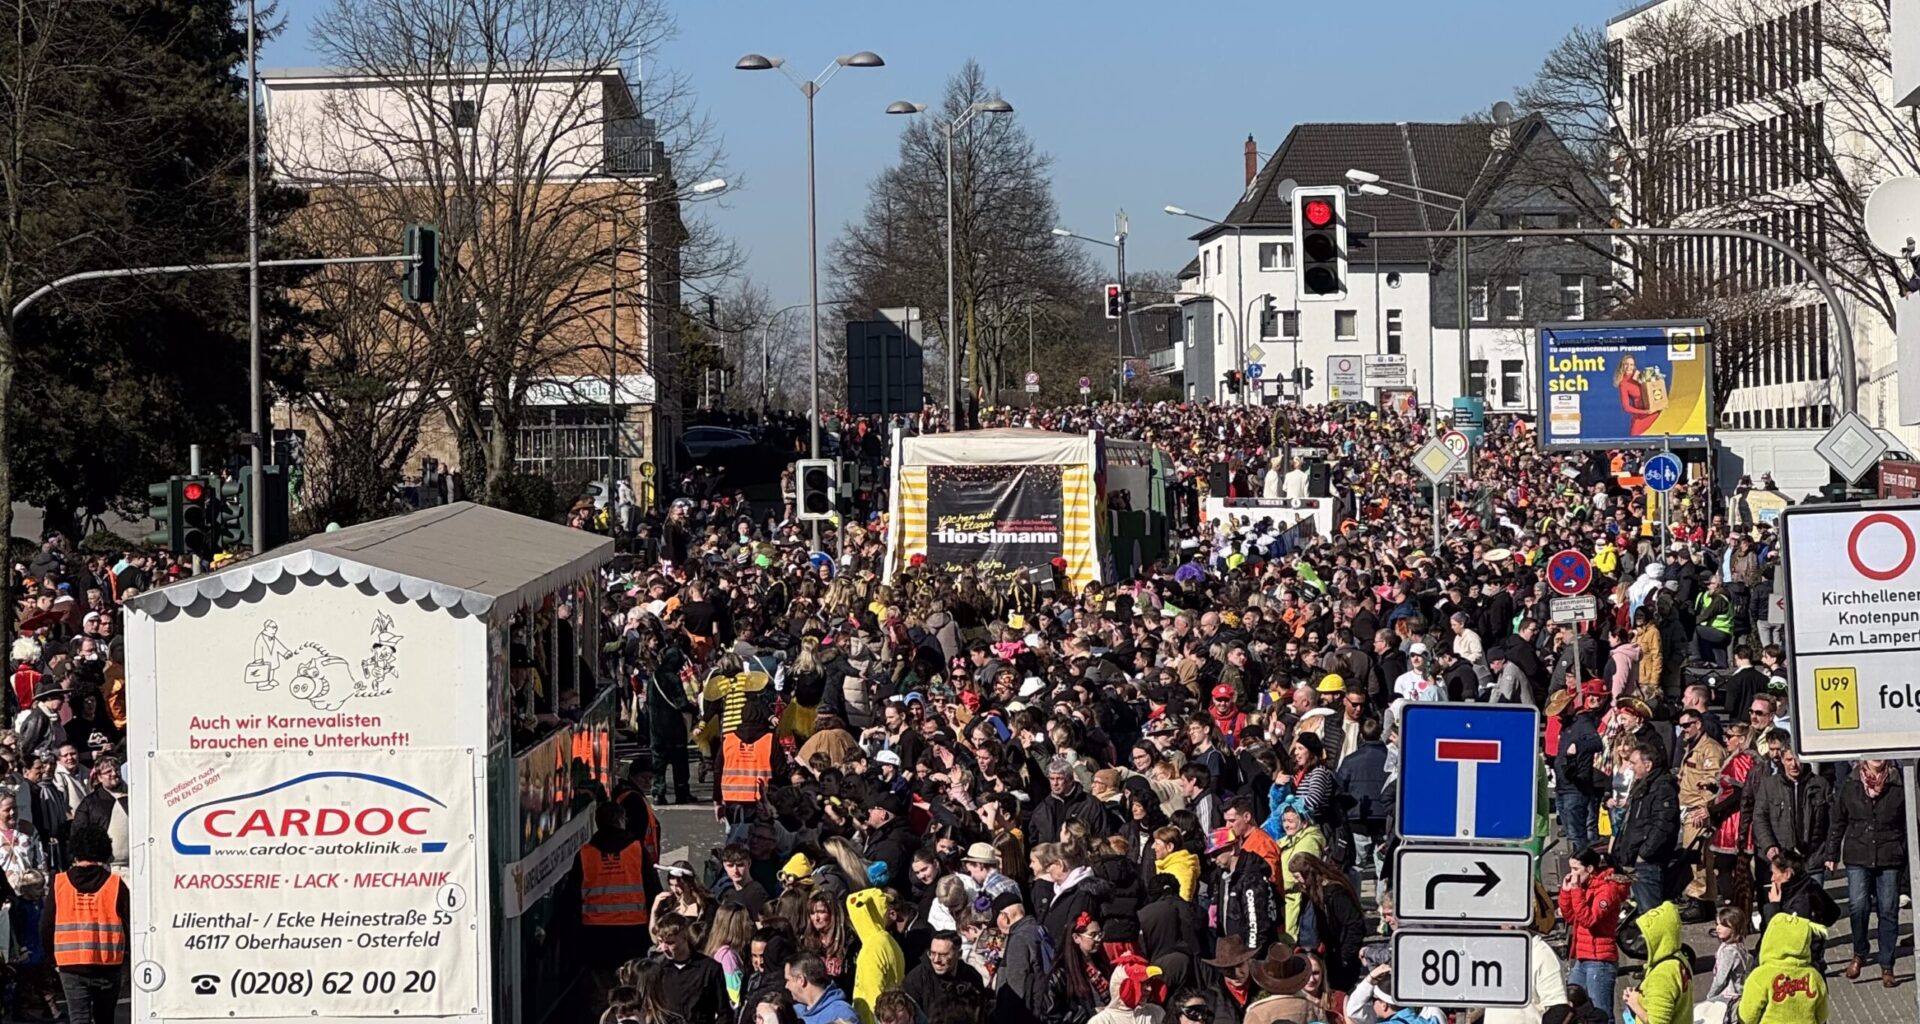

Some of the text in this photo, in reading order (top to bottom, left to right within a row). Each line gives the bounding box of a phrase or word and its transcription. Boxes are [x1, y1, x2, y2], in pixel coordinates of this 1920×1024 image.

[1549, 355, 1605, 372] Lohnt
[1549, 375, 1588, 392] sich
[1448, 438, 1462, 451] 30
[955, 521, 994, 532] 3 Etagen
[935, 528, 1057, 544] Horstmann
[1829, 632, 1854, 646] Am
[1820, 677, 1849, 691] U99
[189, 713, 381, 729] Auch wir Karnevalisten
[190, 732, 409, 749] brauchen eine Unterkunft!
[163, 768, 215, 800] zertifiziert nach
[167, 773, 221, 807] DIN EN ISO 9001
[204, 807, 431, 837] CARDOC
[214, 841, 418, 856] www.cardoc-autoklinik.de
[173, 871, 451, 889] KAROSSERIE LACK MECHANIK
[447, 888, 456, 907] 6
[172, 912, 259, 929] Lilienthal-
[277, 912, 315, 928] Ecke
[320, 910, 427, 927] Heinestraße
[432, 910, 453, 925] 55
[1245, 889, 1258, 948] CONNECTION
[184, 934, 229, 950] 46117
[235, 934, 342, 949] Oberhausen
[357, 931, 440, 948] Osterfeld
[143, 968, 151, 984] 6
[1421, 949, 1502, 987] 80 m
[230, 969, 436, 997] (0208) 62 00 20
